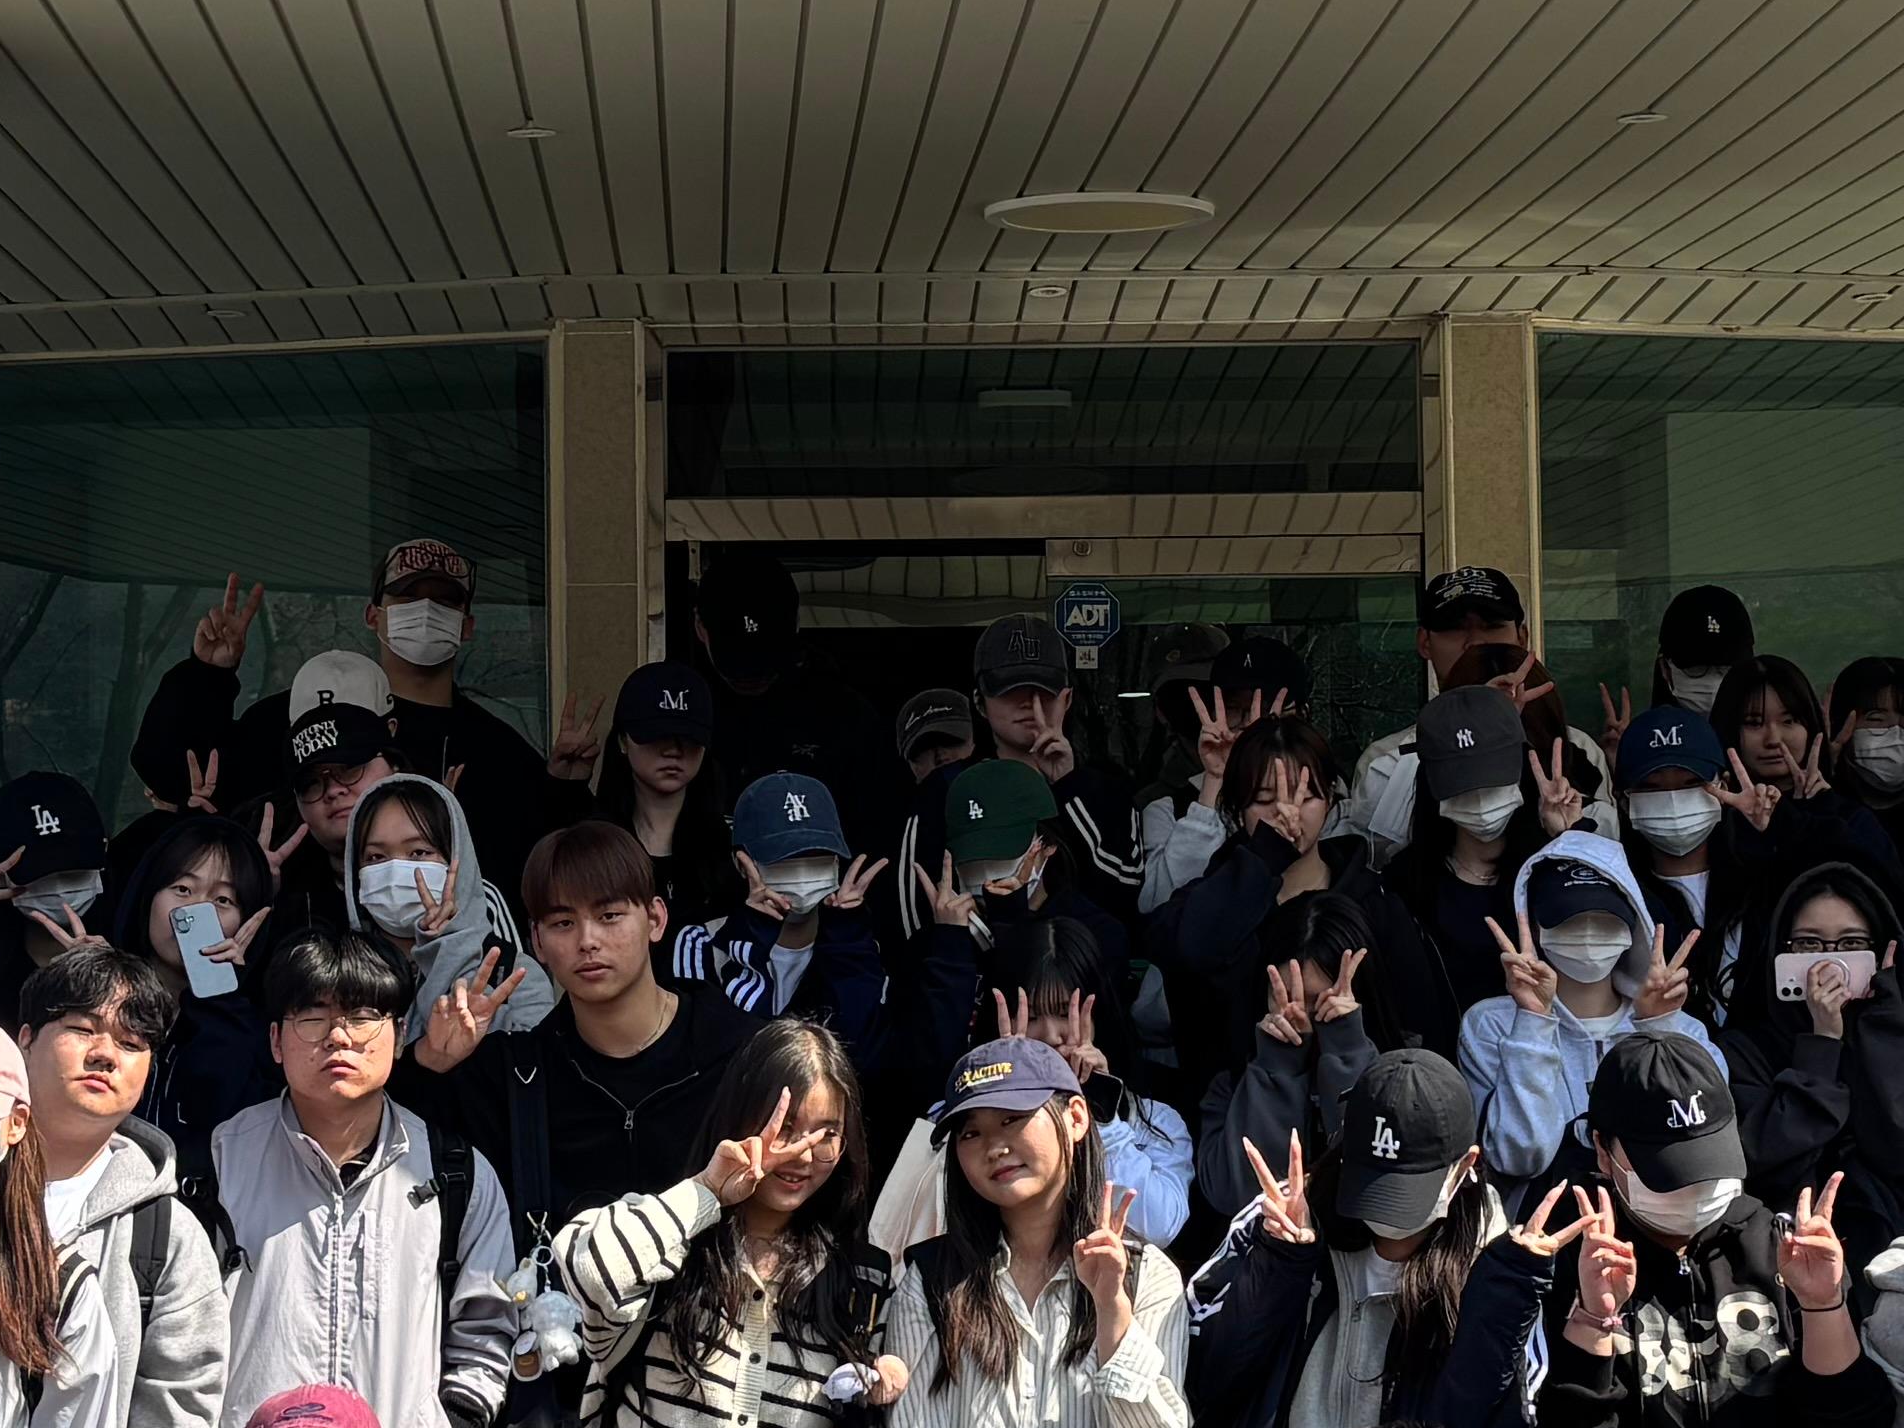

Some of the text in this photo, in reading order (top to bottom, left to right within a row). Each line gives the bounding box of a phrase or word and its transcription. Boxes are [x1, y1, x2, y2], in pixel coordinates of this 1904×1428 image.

[1066, 604, 1110, 628] ADT
[298, 732, 339, 763] TODAY
[30, 804, 61, 836] LA
[1371, 1115, 1400, 1160] LA
